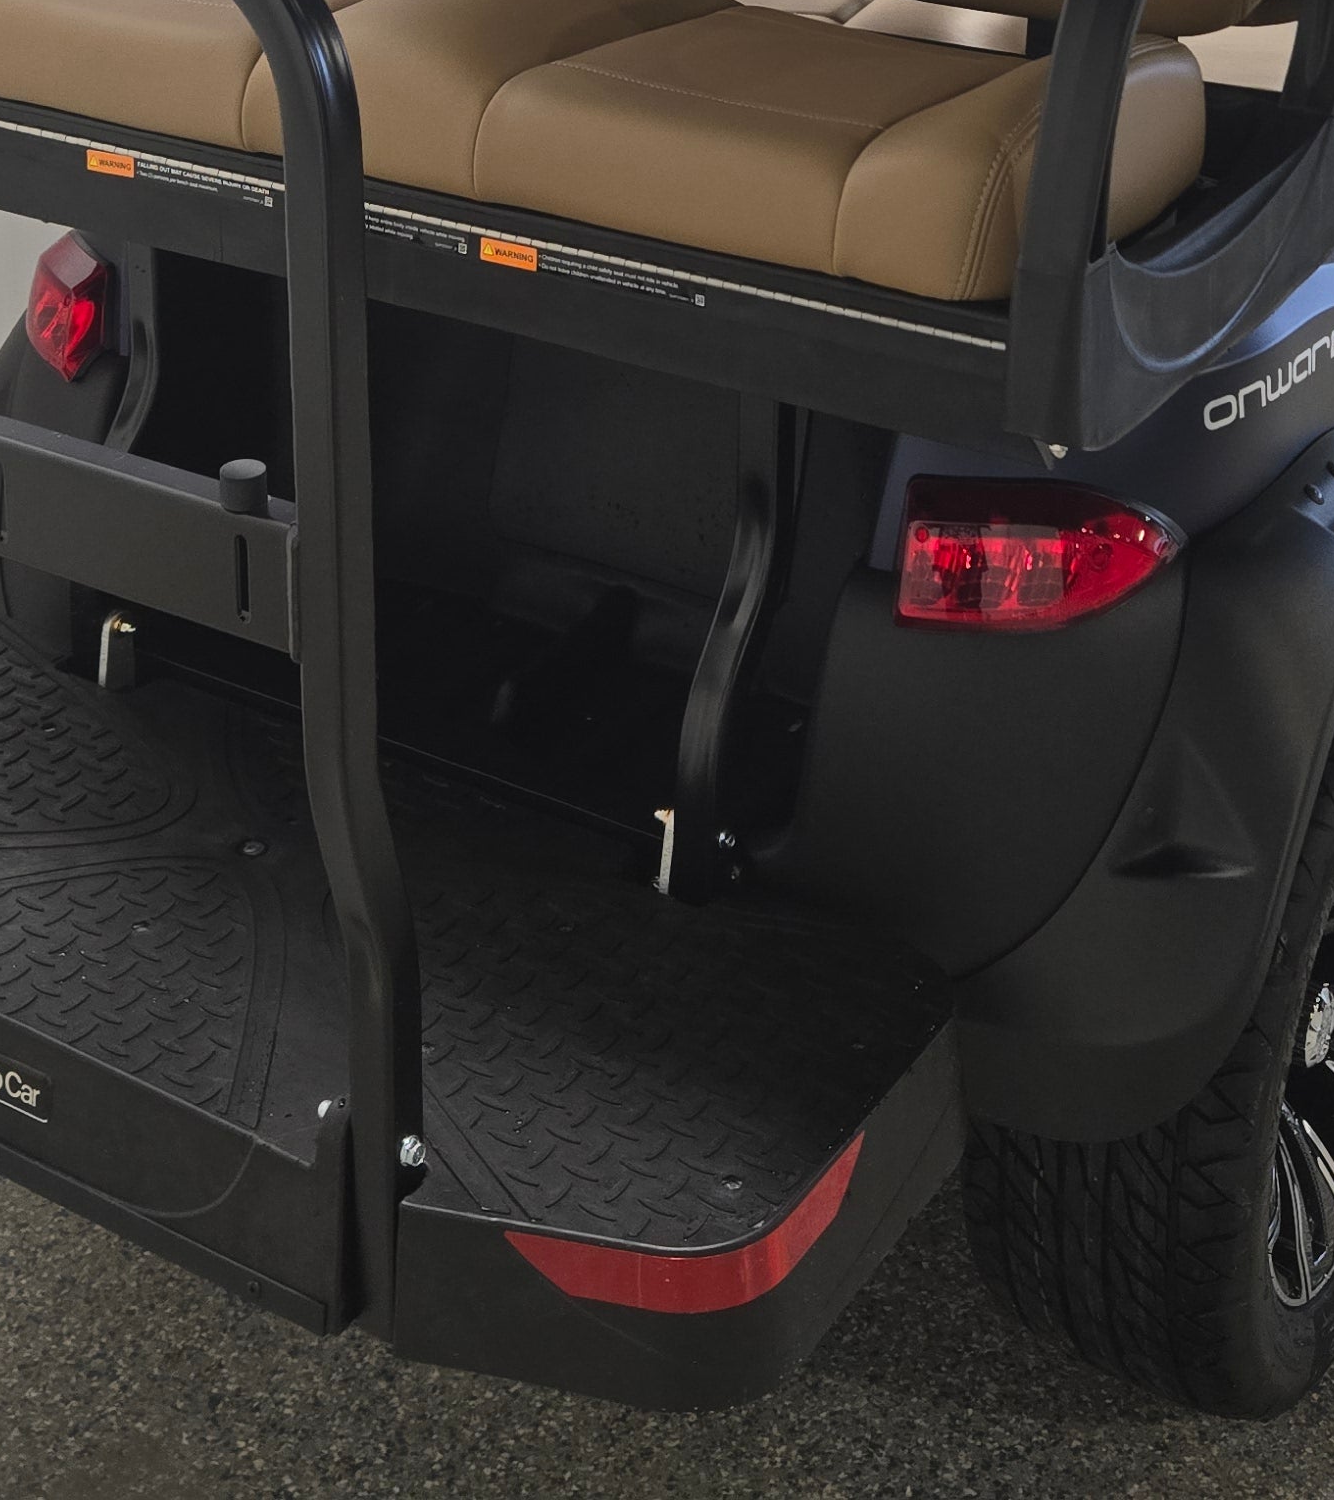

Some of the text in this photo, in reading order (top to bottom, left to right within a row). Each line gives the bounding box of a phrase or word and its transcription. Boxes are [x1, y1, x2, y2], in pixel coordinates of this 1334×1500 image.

[99, 160, 131, 171] WARNING
[137, 162, 158, 170] FALLING
[495, 248, 533, 262] WARNING
[5, 1071, 40, 1107] Car
